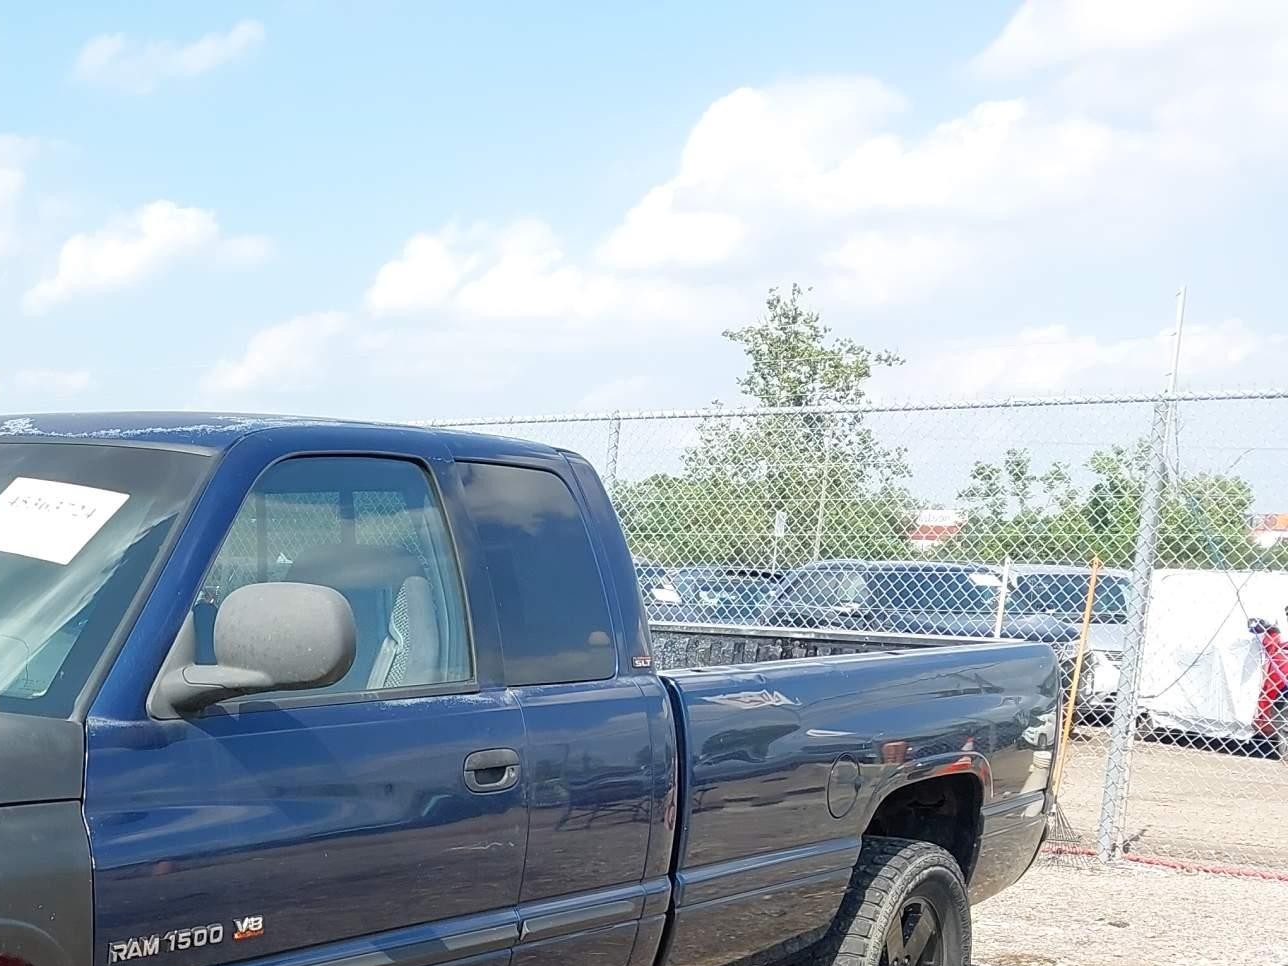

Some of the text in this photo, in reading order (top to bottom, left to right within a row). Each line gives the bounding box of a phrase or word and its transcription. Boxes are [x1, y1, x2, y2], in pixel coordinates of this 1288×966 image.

[634, 659, 651, 667] SLT
[232, 915, 264, 933] V8
[108, 923, 224, 966] RAM 1500
